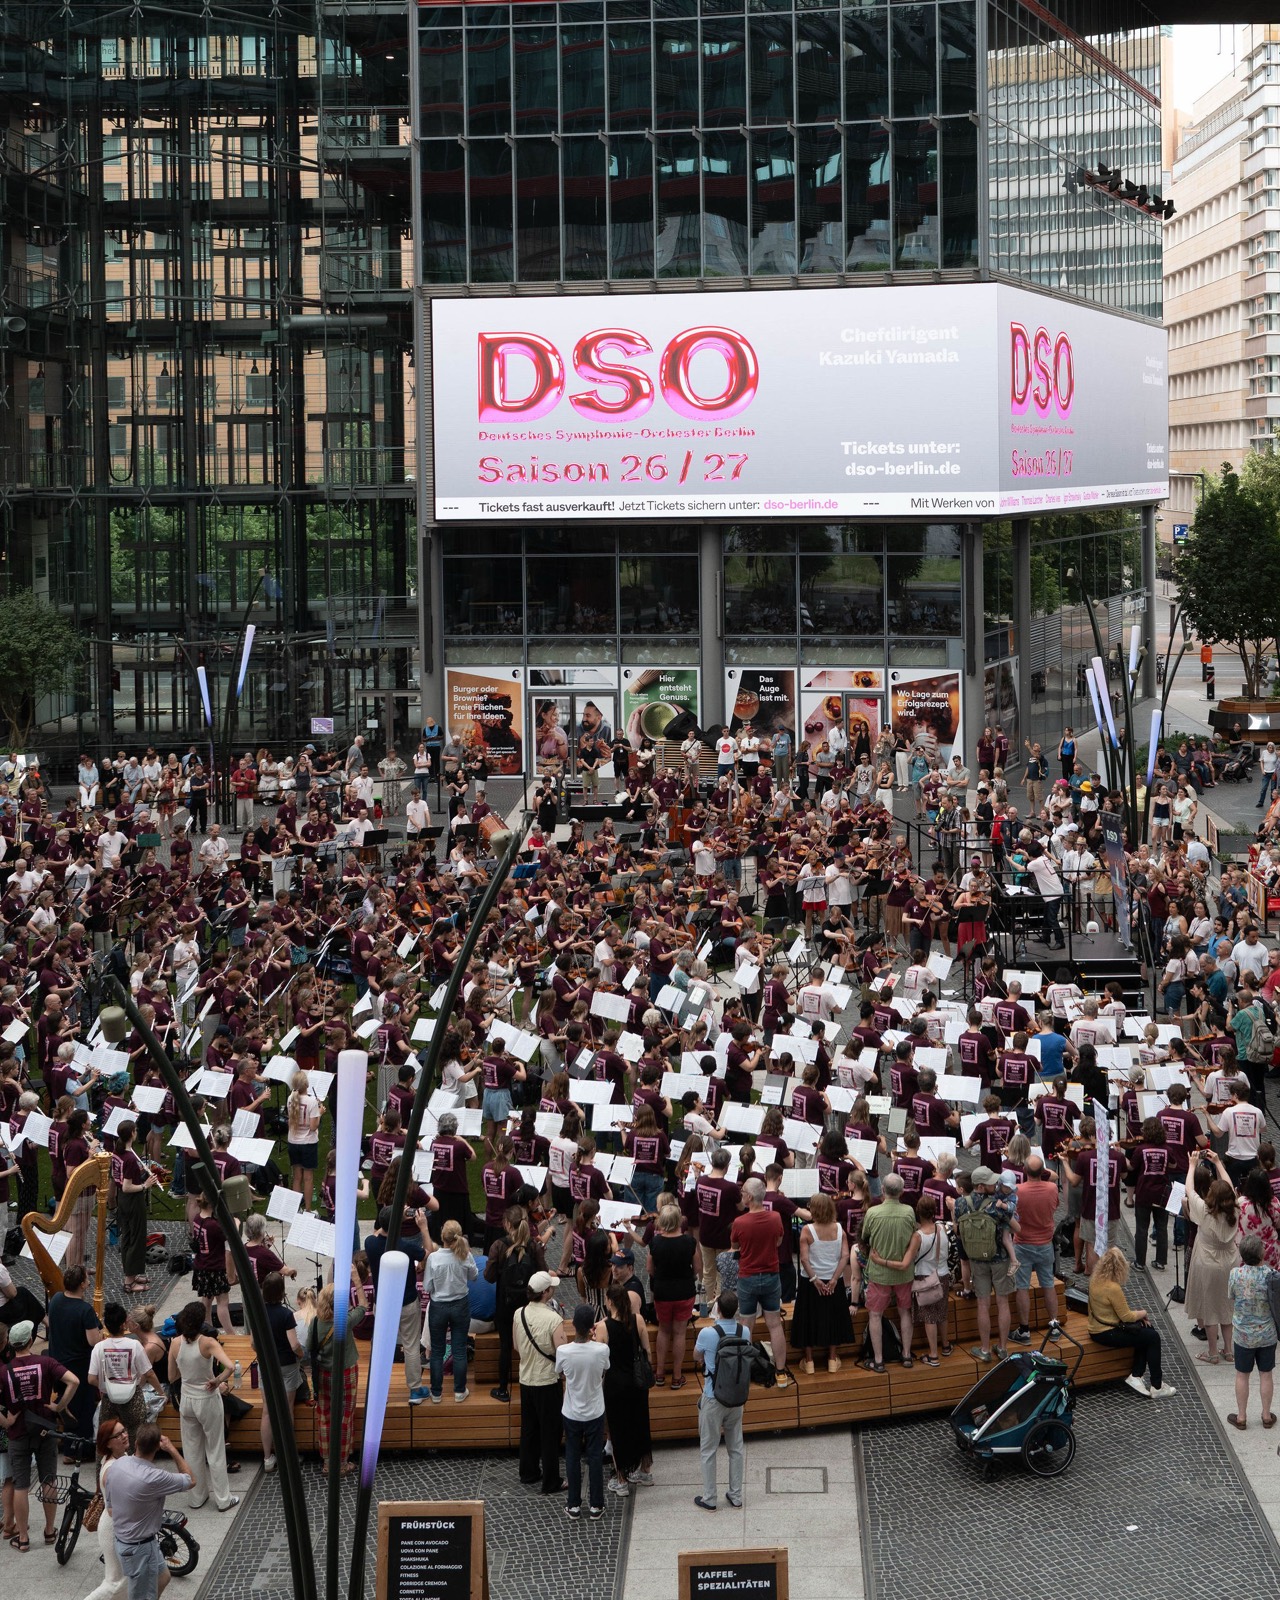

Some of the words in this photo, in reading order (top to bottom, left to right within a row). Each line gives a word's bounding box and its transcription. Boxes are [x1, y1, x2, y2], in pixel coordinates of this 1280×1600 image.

[841, 326, 959, 344] Chefdirigent
[820, 351, 881, 366] Kazuki
[885, 349, 960, 364] Yamada
[478, 326, 759, 423] DSO
[1011, 322, 1074, 420] DSO
[478, 430, 552, 440] Deutsches
[556, 428, 711, 442] Symphonie-Orchester
[714, 427, 756, 438] Berlin
[841, 442, 905, 455] Tickets
[908, 442, 960, 454] unter:
[478, 456, 609, 484] Saison
[620, 454, 669, 482] 26
[704, 453, 749, 482] 27
[845, 461, 960, 476] dso-berlin.de
[1012, 448, 1044, 478] Saison
[479, 502, 520, 513] Tickets
[522, 502, 543, 512] fast
[545, 500, 615, 512] ausverkauft!
[619, 500, 646, 512] Jetzt
[646, 500, 686, 512] Tickets
[688, 500, 726, 511] sichern
[728, 500, 760, 510] unter:
[764, 499, 838, 510] dso-berlin.de
[910, 498, 930, 509] Mit
[930, 498, 974, 508] Werken
[976, 500, 994, 508] von
[1175, 526, 1180, 534] P
[453, 686, 479, 694] Burger
[759, 685, 779, 694] Auge
[912, 690, 930, 699] Lage
[897, 699, 949, 709] Erfolgsrezept
[401, 1521, 455, 1529] FRÜHSTÜCK
[698, 1571, 736, 1579] KAFFEE-
[698, 1580, 770, 1590] SPEZIALITÄTEN
